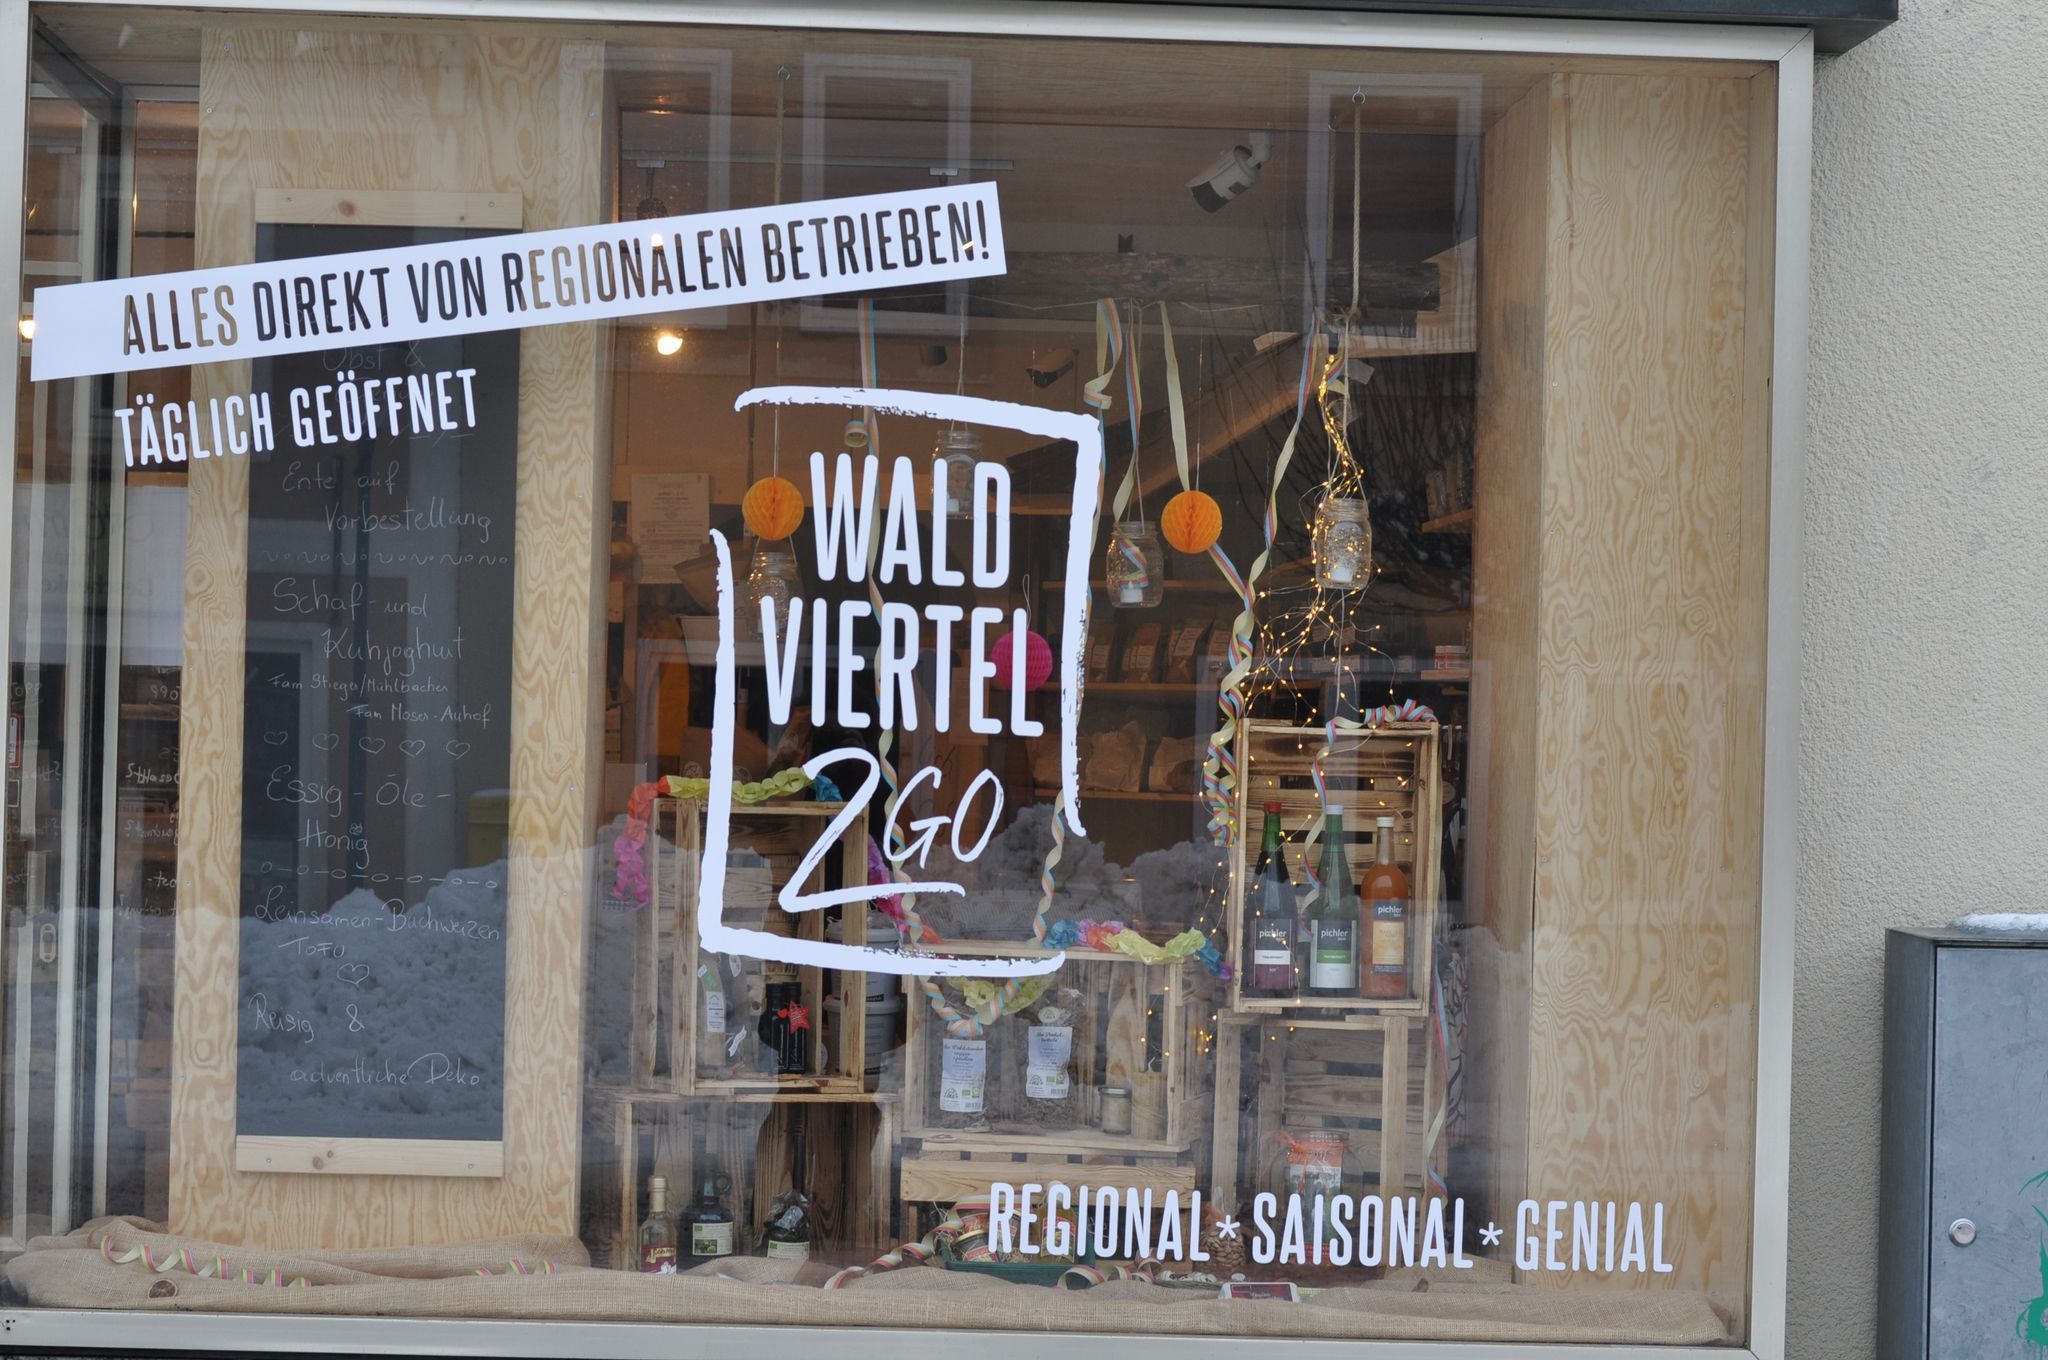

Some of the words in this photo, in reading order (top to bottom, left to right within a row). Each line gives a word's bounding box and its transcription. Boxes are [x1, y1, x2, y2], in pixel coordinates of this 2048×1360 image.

[122, 285, 239, 357] ALLES
[252, 266, 391, 342] DIREKT
[406, 255, 488, 324] VON
[500, 225, 748, 315] REGIONALEN
[760, 199, 991, 285] BETRIEBEN!
[114, 392, 275, 468] TÄGLICH
[289, 368, 477, 447] GEÖFFNET
[282, 460, 337, 492] Ente
[357, 460, 400, 495] auf
[324, 495, 492, 543] Vorbestellung
[810, 451, 1012, 589] WALD
[384, 593, 427, 618] und
[759, 594, 1045, 738] VIERTEL
[266, 764, 342, 818] Essig
[296, 818, 370, 870] Honig
[1320, 928, 1349, 939] pichler
[1377, 904, 1403, 915] pichler
[247, 992, 314, 1043] Reisig
[345, 1003, 366, 1033] &
[407, 1052, 480, 1086] Deko
[987, 1181, 1211, 1262] REGIONAL
[1251, 1191, 1475, 1270] SAISONAL
[1514, 1198, 1674, 1274] GENIAL
